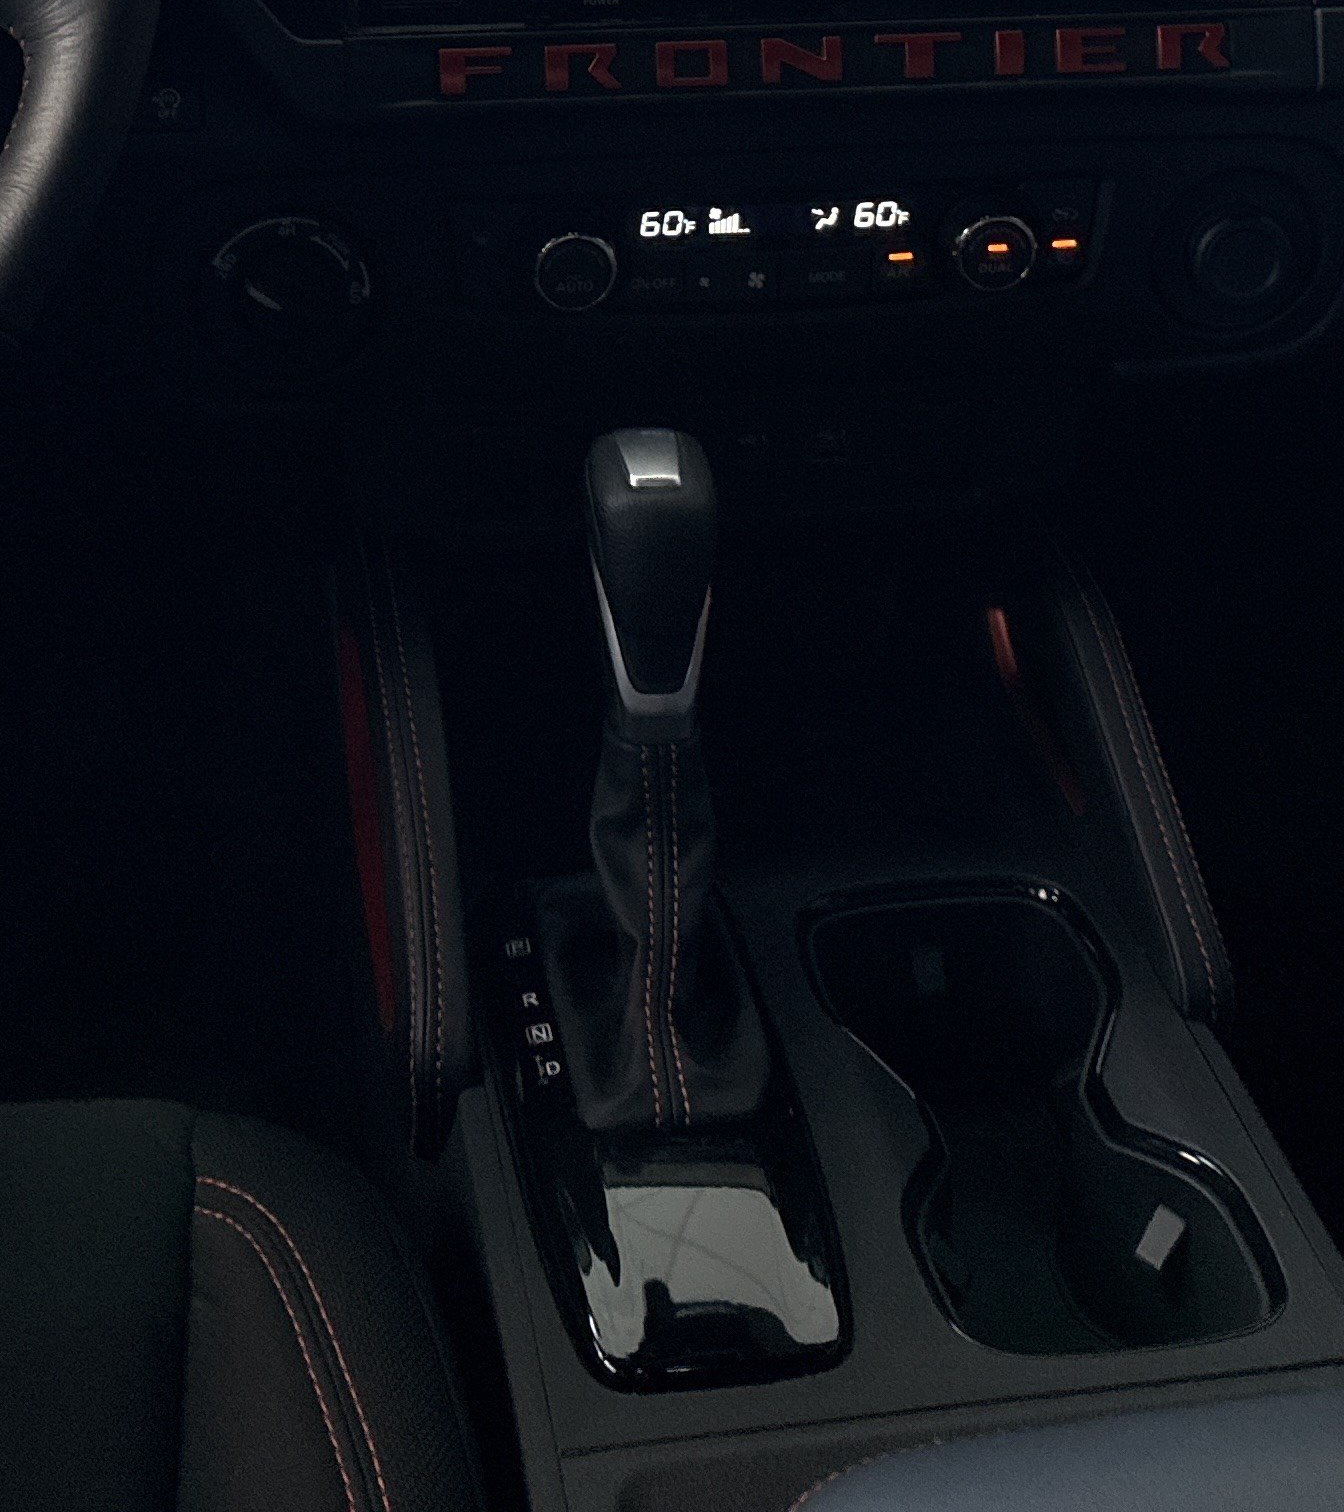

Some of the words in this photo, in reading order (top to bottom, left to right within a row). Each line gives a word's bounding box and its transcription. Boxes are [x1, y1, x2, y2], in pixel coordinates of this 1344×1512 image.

[438, 22, 1231, 95] FRONTIER
[521, 991, 540, 1008] R
[545, 1060, 561, 1076] D
